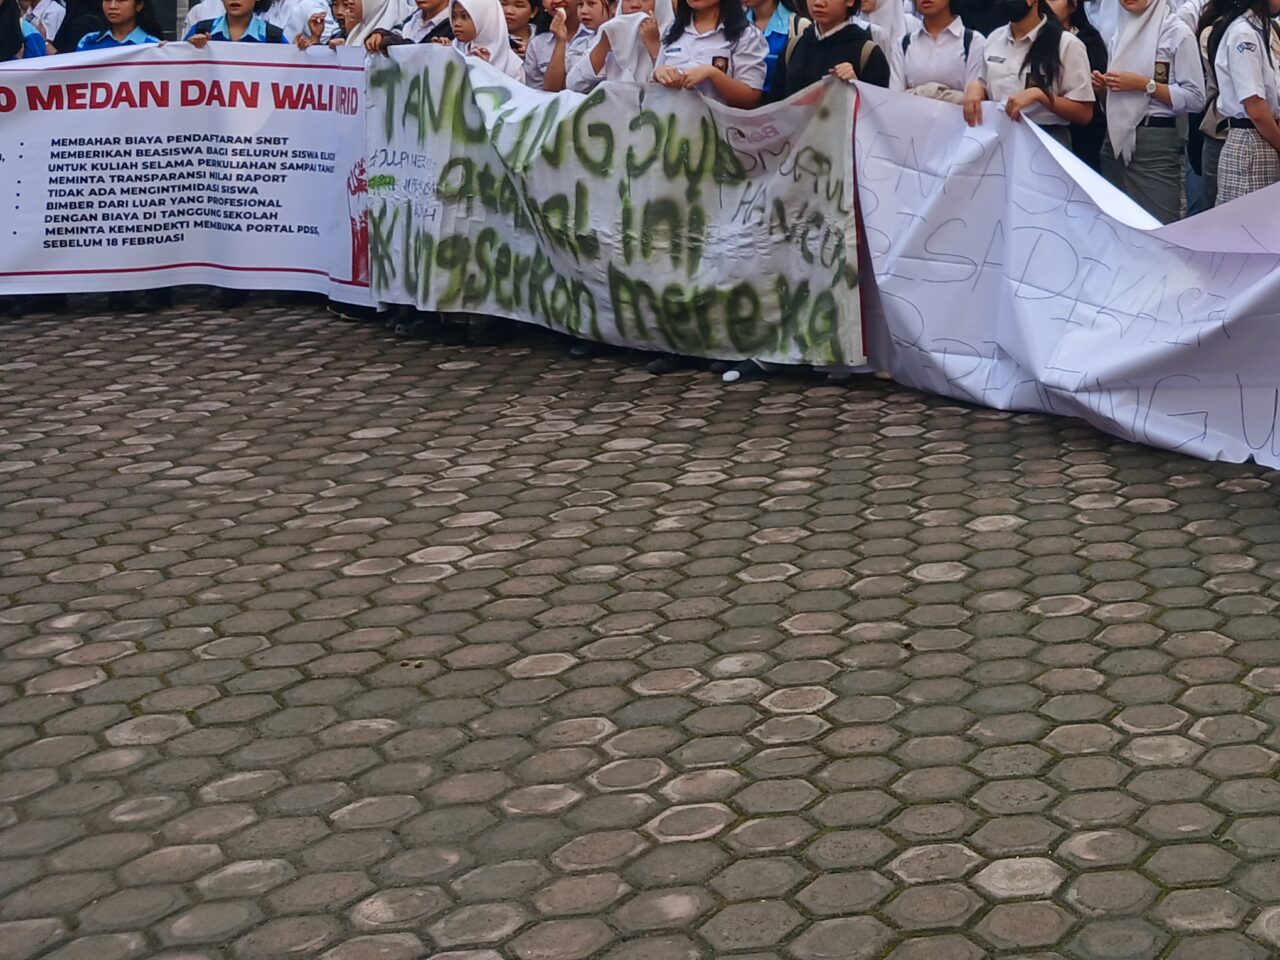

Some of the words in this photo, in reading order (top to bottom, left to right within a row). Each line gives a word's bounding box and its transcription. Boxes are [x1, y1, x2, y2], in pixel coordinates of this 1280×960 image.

[26, 80, 170, 111] MEDAN
[180, 79, 259, 108] DAN
[271, 82, 334, 111] WALI
[124, 135, 163, 145] BIAYA
[167, 133, 252, 145] PENDAFTARAN
[256, 136, 289, 146] SNBT
[50, 149, 132, 159] MEMBERIKAN
[136, 146, 203, 157] BEASISWA
[207, 146, 228, 156] BAGI
[231, 148, 288, 158] SELURUH
[291, 150, 319, 160] SISWA
[48, 163, 88, 172] UNTUK
[91, 161, 138, 171] KULIAH
[142, 159, 194, 169] SELAMA
[198, 158, 277, 171] PERKULIAHAN
[280, 162, 317, 172] SAMPAI
[48, 175, 106, 185] MEMINTA
[109, 170, 206, 183] TRANSPARANSI
[209, 172, 232, 182] NILAI
[236, 174, 288, 183] RAPORT
[47, 188, 84, 198] TIDAK
[88, 187, 117, 197] ADA
[120, 183, 219, 195] MENGINTIMIDASI
[221, 185, 259, 195] SISWA
[46, 201, 94, 211] BIMBER
[98, 200, 129, 209] DARI
[132, 198, 166, 208] LUAR
[170, 196, 204, 206] YANG
[207, 196, 283, 208] PROFESIONAL
[44, 213, 98, 223] DENGAN
[102, 212, 139, 221] BIAYA
[143, 211, 156, 220] DI
[160, 207, 222, 220] TANGGUNG
[223, 210, 278, 220] SEKOLAH
[45, 226, 106, 236] MEMINTA
[108, 221, 190, 234] KEMENDEKTI
[194, 220, 243, 232] MEMBUKA
[246, 224, 295, 233] PORTAL
[43, 239, 103, 249] SEBELUM
[106, 238, 118, 246] 18
